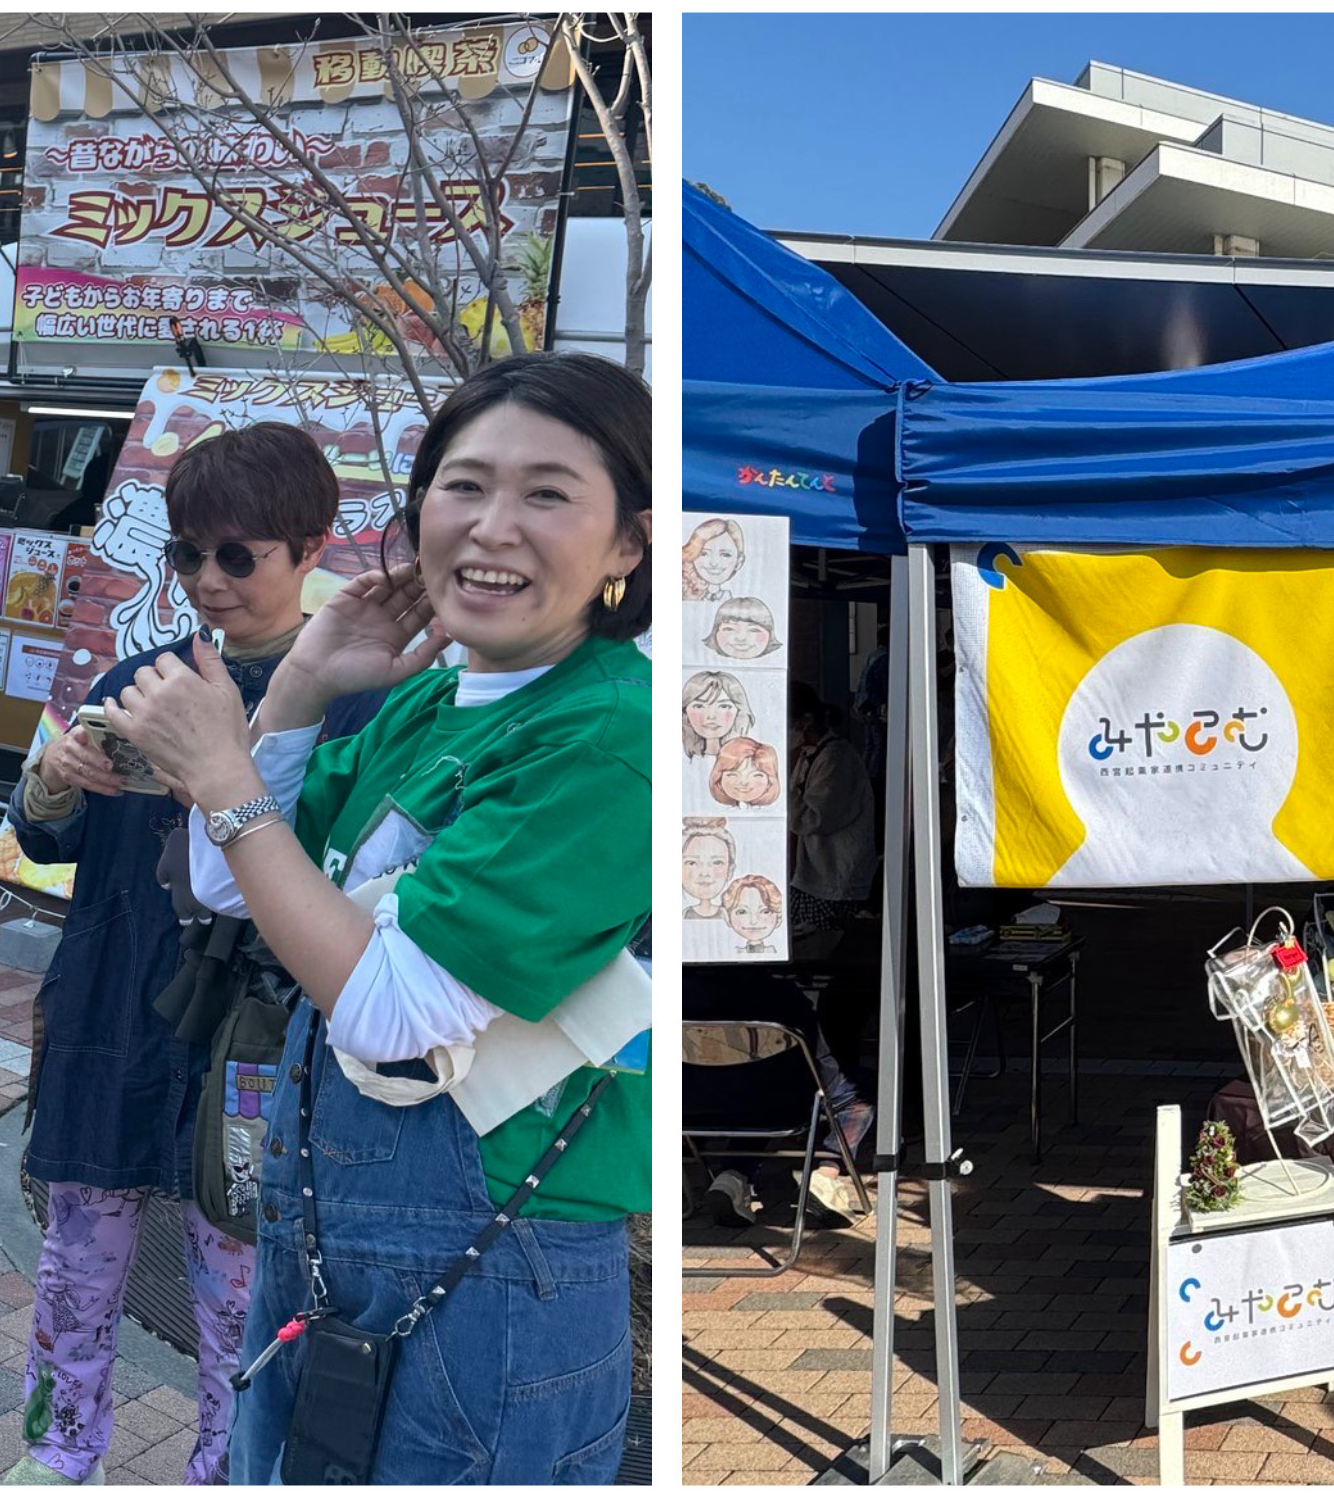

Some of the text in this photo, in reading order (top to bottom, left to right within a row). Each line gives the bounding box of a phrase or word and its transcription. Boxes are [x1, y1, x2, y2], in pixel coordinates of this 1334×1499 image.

[313, 36, 499, 88] 移動喫茶
[47, 178, 517, 252] ミックスジュース
[21, 284, 255, 313] 子どもからお年寄りまで
[737, 465, 837, 493] かんたんてんと
[1088, 706, 1269, 761] みやこむ
[1099, 760, 1258, 777] 西宮起業家連携コミュニティ
